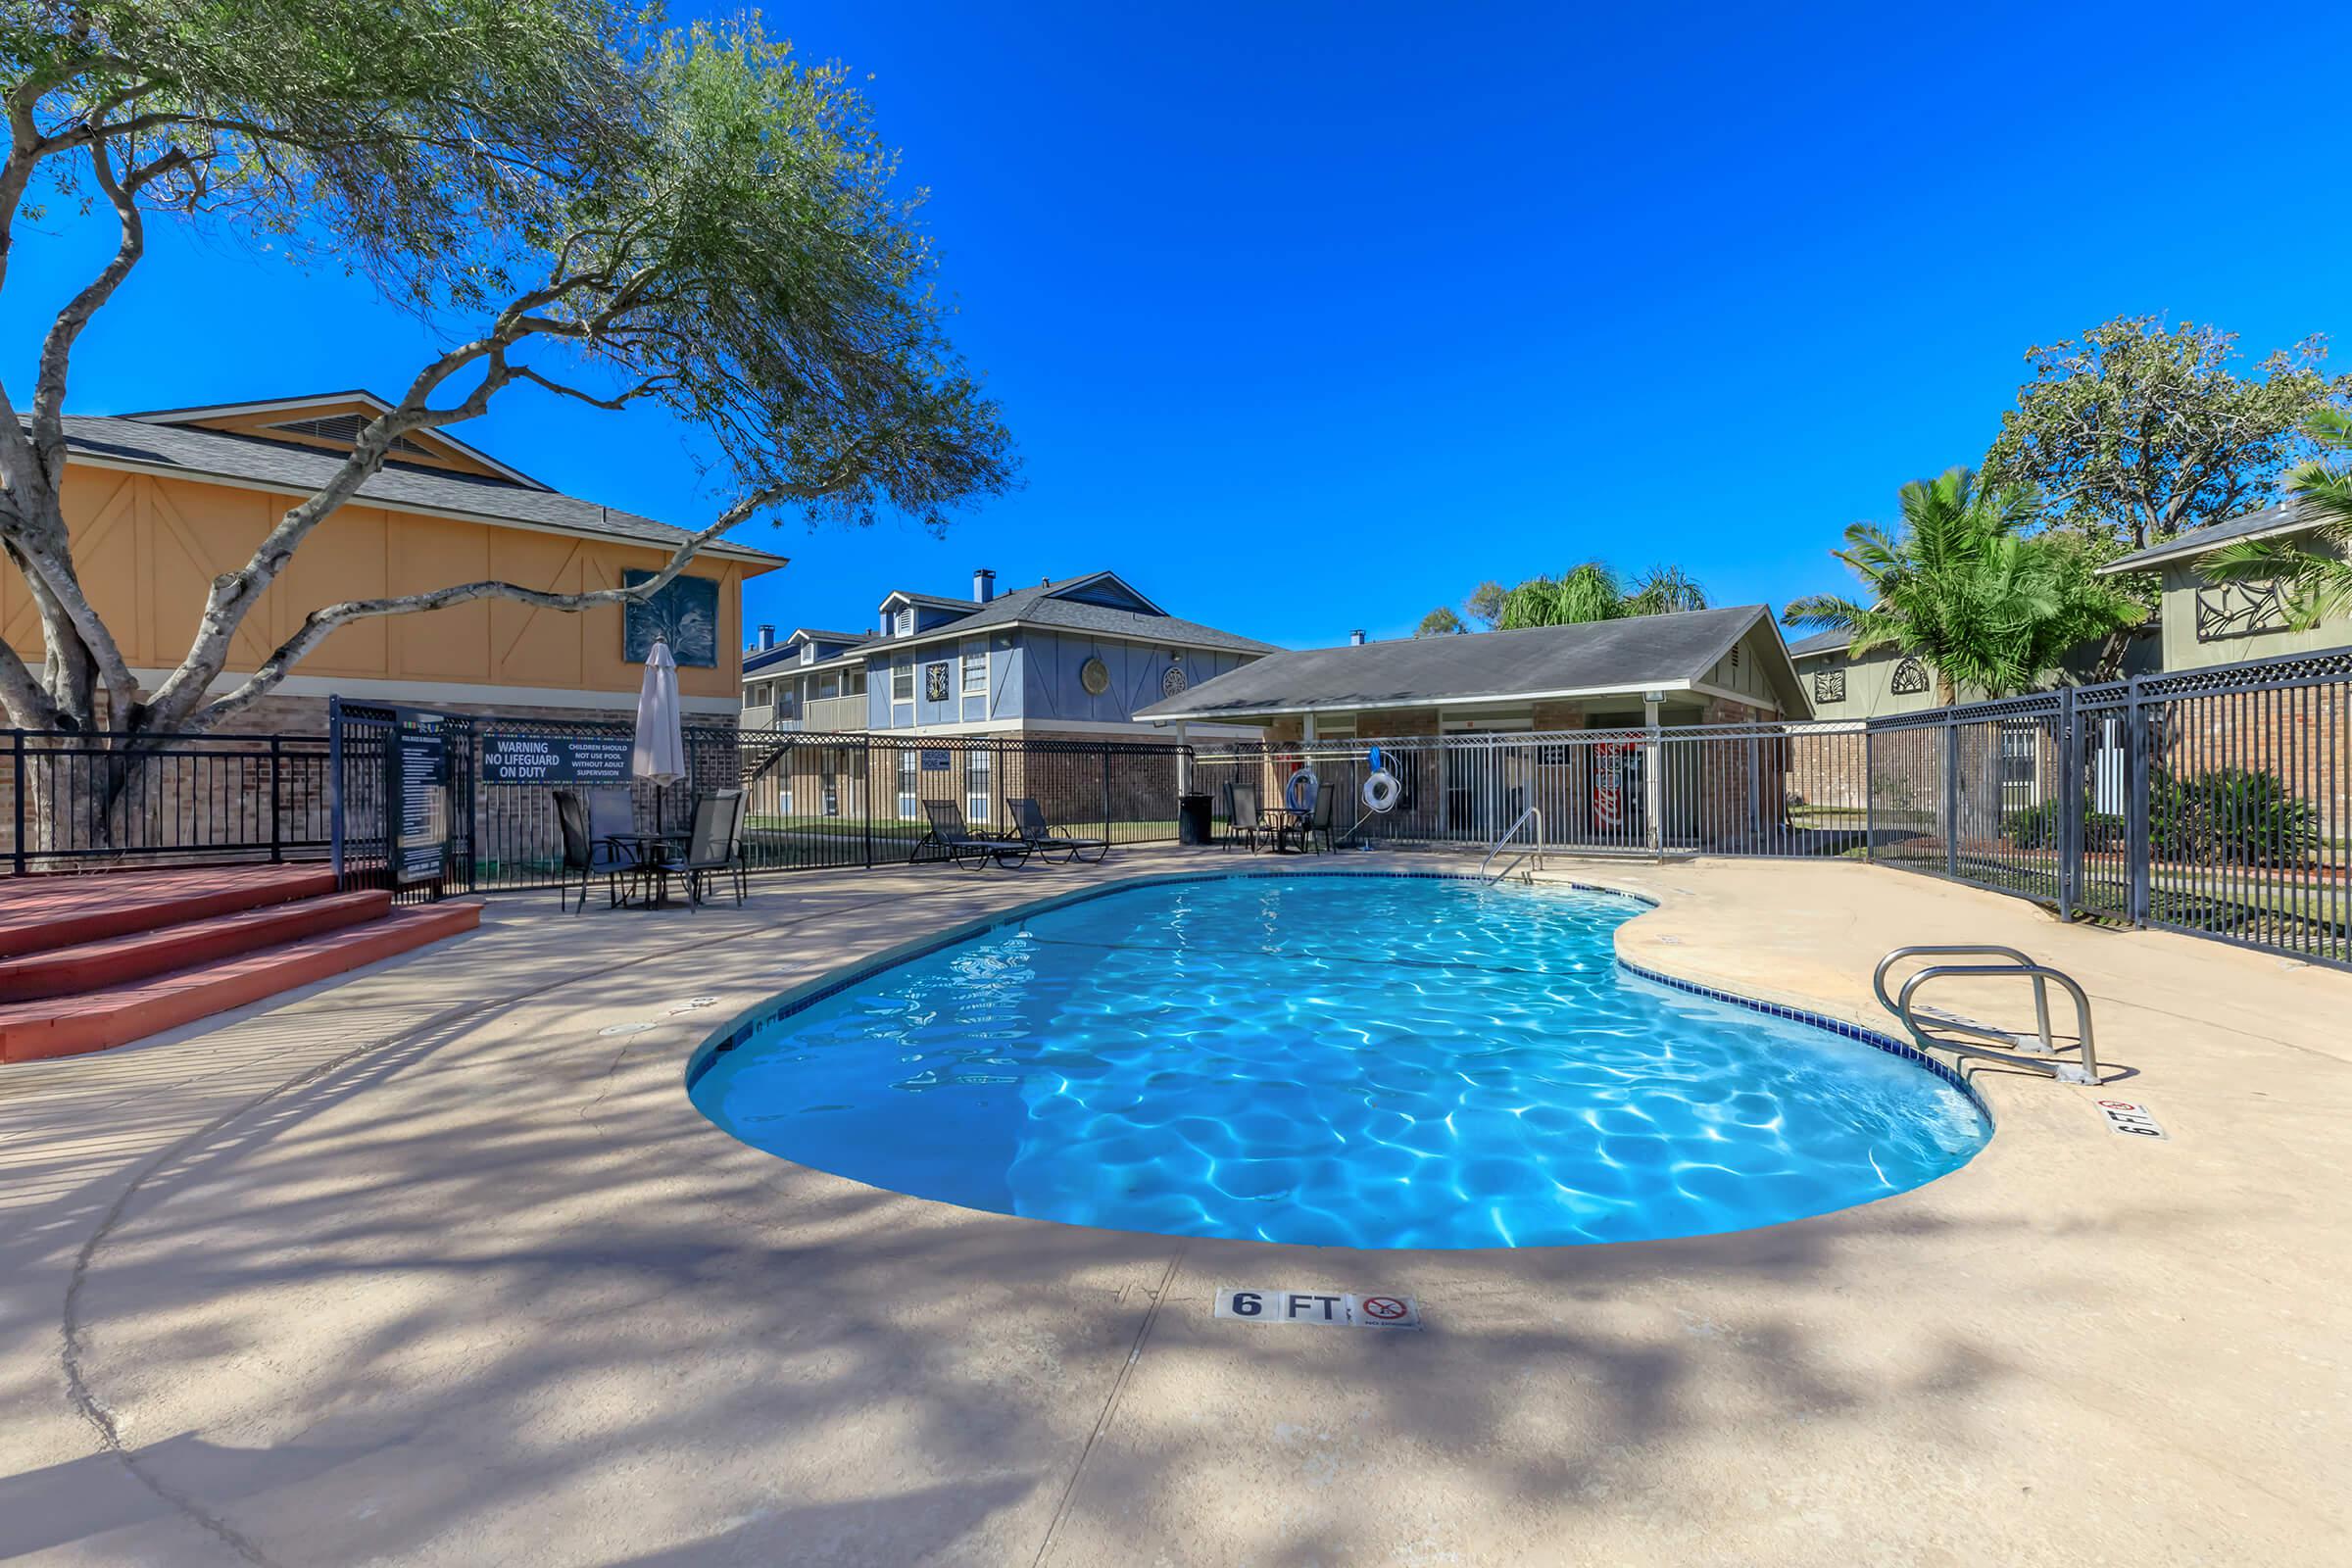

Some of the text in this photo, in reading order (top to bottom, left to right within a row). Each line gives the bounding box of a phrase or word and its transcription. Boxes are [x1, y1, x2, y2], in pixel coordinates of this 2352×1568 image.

[497, 741, 549, 753] WARNING
[485, 754, 560, 765] NO LIFEGUARD
[500, 766, 546, 777] ON DUTY
[2107, 1110, 2160, 1137] 6 FT
[1232, 1293, 1341, 1320] 6 FT
